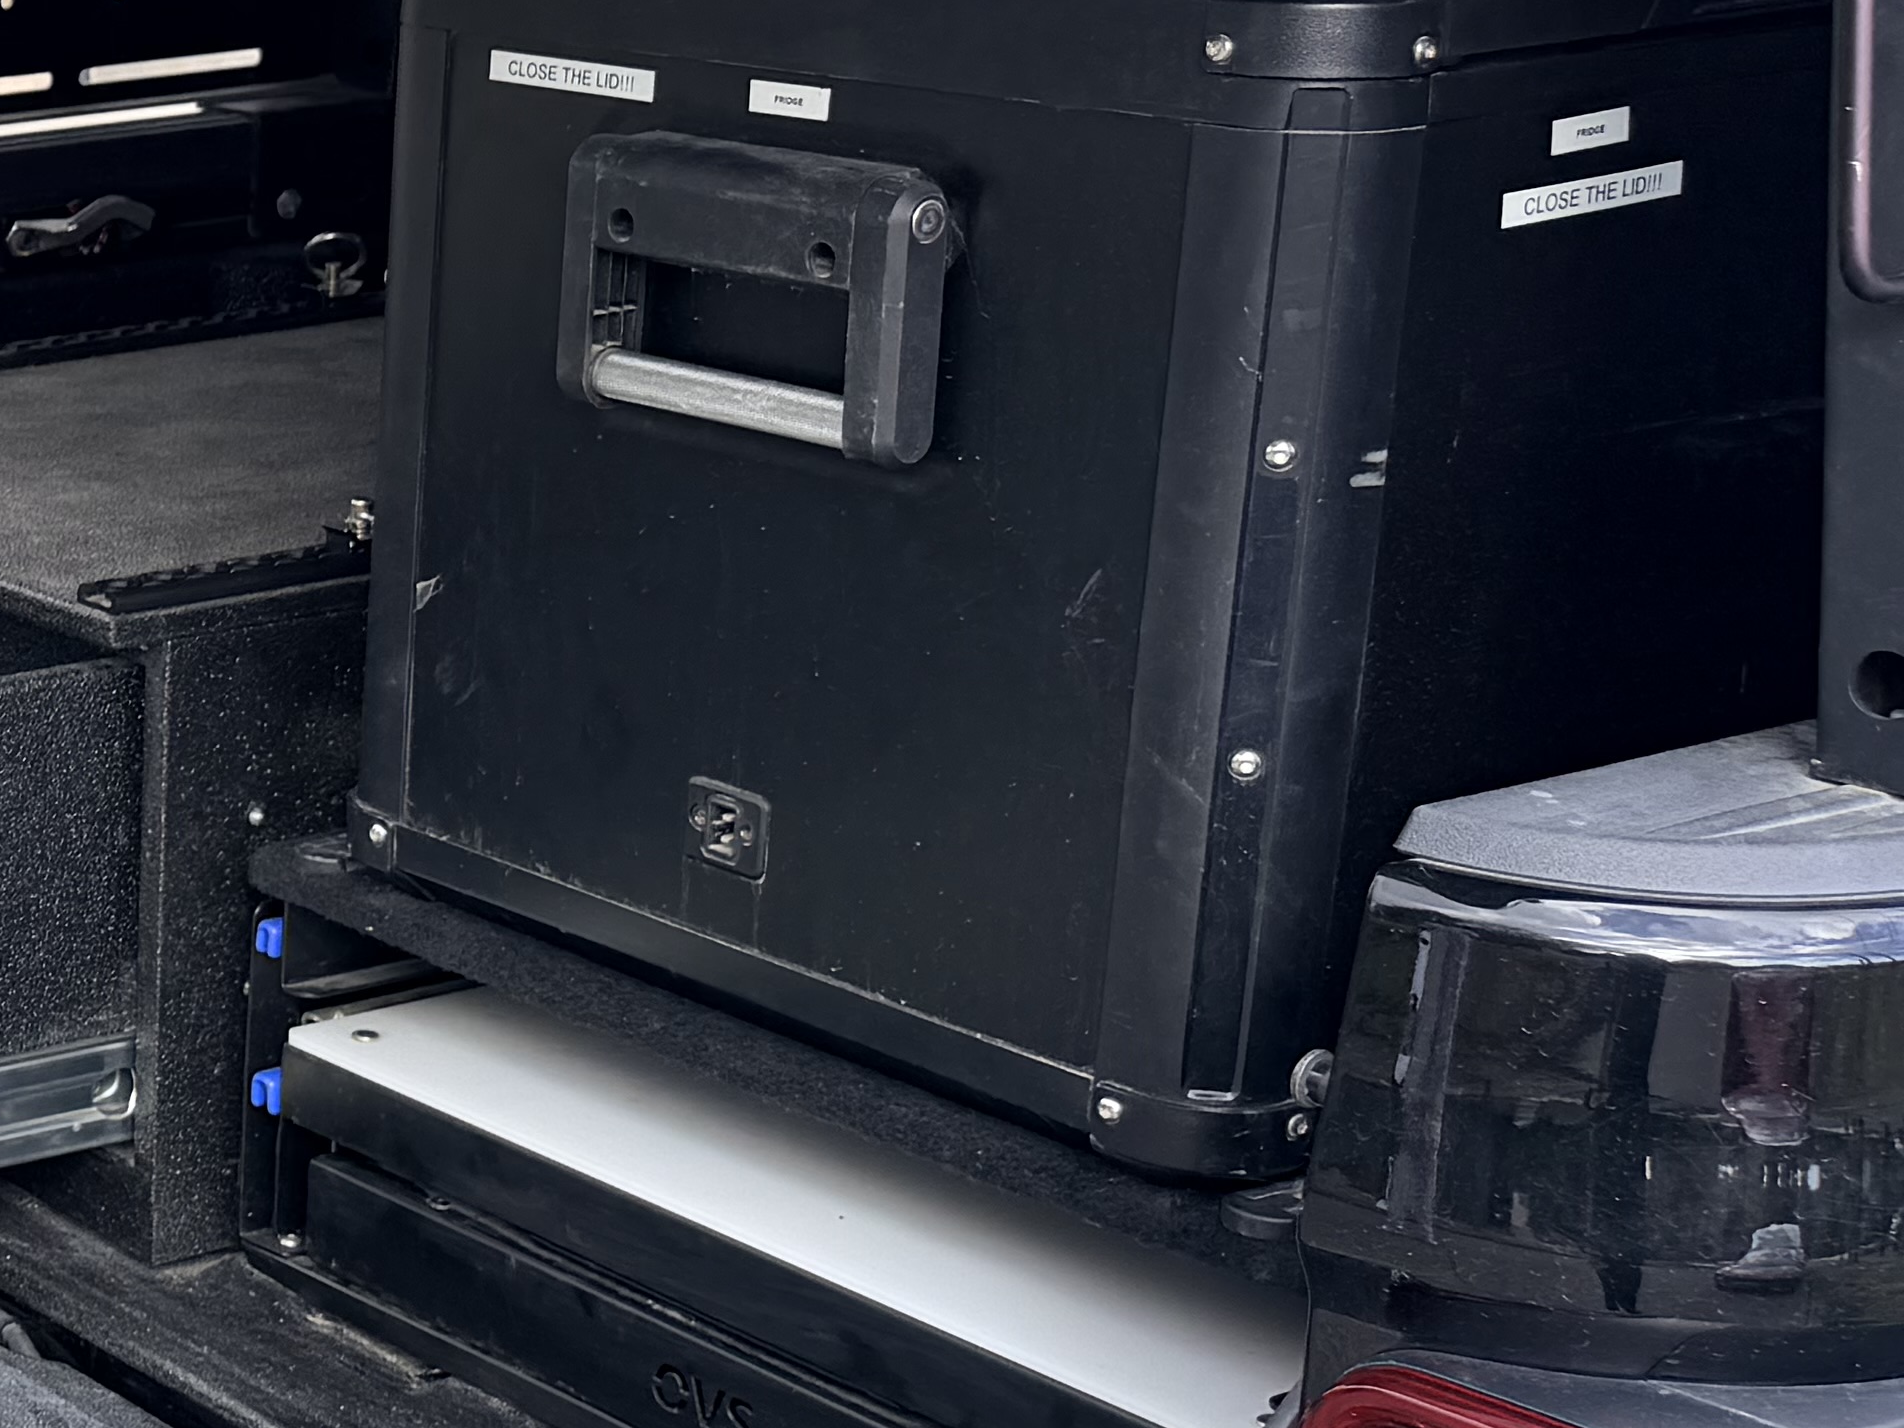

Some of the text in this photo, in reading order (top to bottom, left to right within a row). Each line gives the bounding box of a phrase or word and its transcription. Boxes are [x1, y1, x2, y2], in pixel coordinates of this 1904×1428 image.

[508, 59, 558, 82] CLOSE
[562, 66, 592, 87] THE
[1576, 124, 1605, 139] FRIDGE
[1524, 172, 1663, 216] CLOSE THE LID!!!
